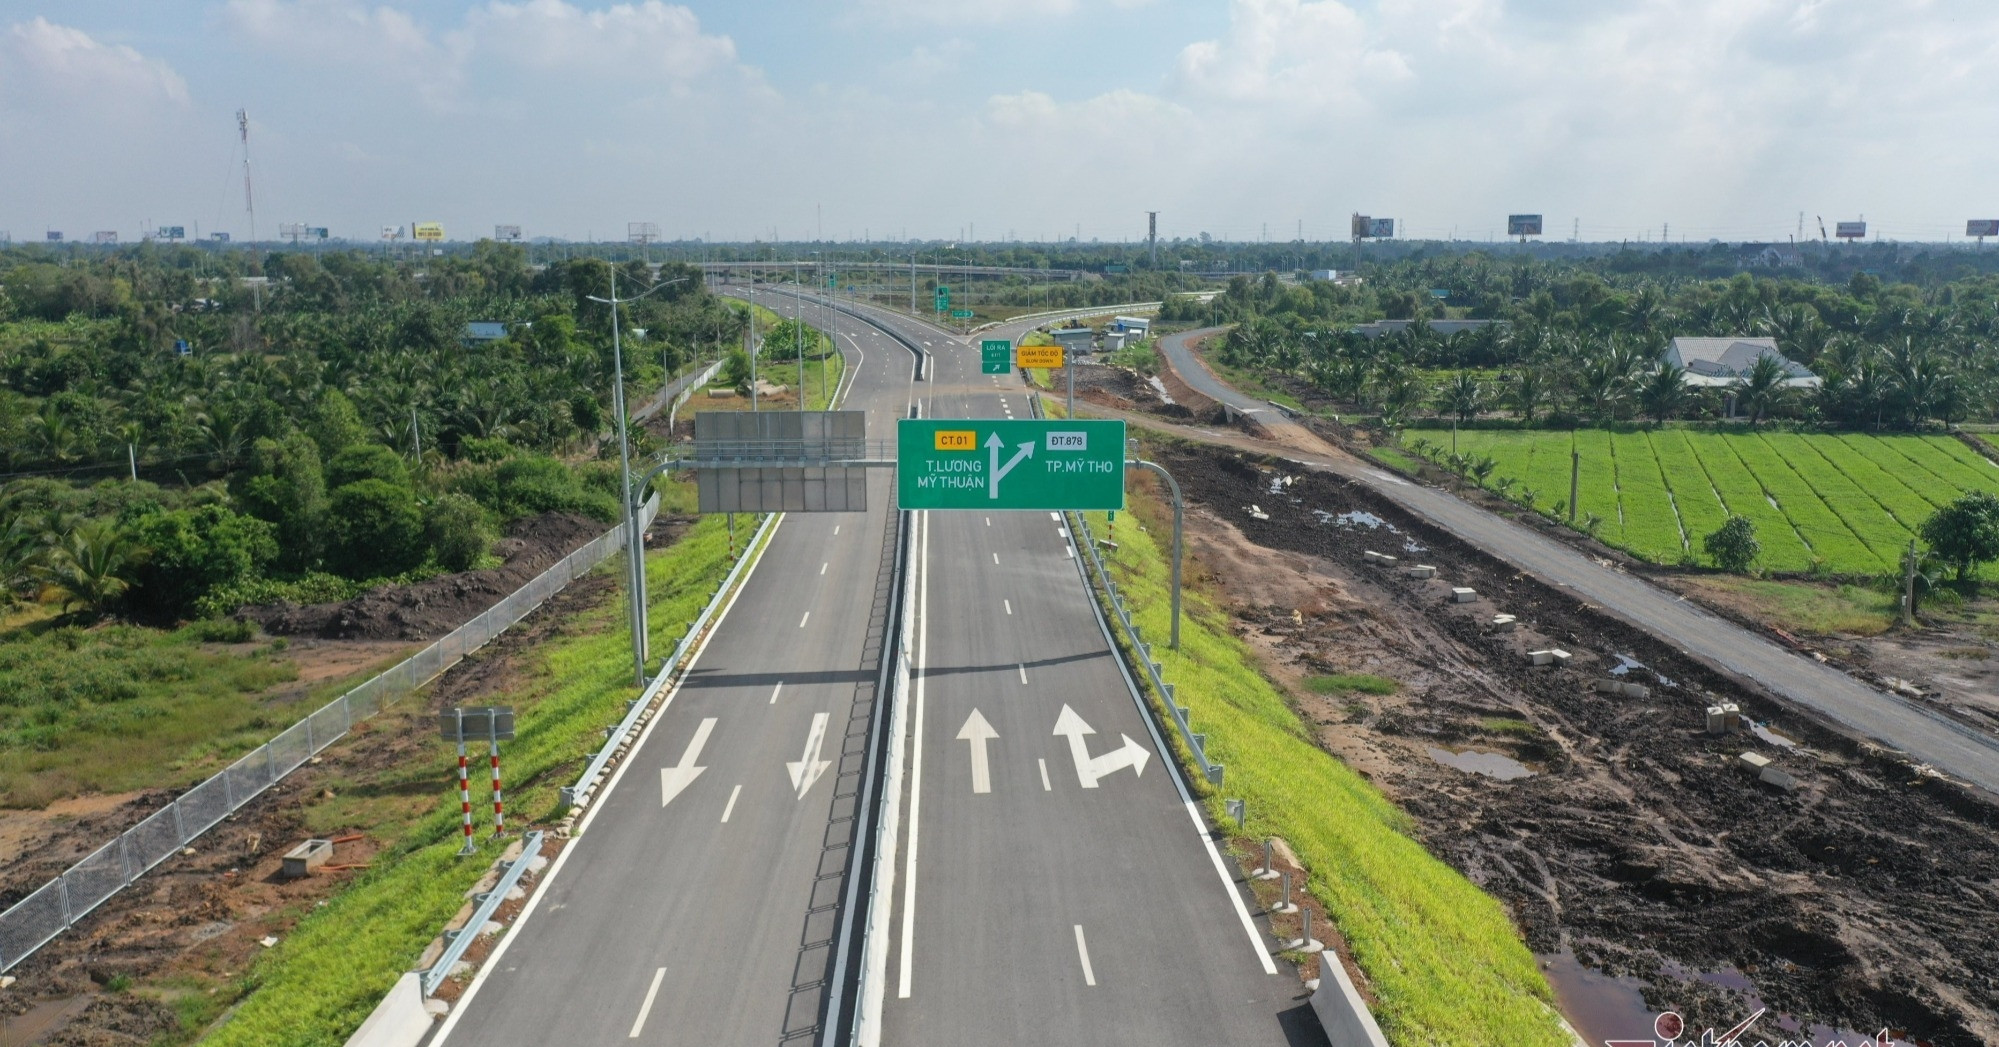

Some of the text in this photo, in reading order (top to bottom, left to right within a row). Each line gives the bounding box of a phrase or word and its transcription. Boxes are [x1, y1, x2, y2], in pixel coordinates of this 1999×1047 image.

[941, 436, 968, 446] CT.01
[1051, 436, 1083, 446] ĐT.878
[925, 459, 982, 473] T.LƯƠNG
[1045, 458, 1113, 473] TP.MỸ THO
[917, 474, 985, 491] MỸ THUẬN
